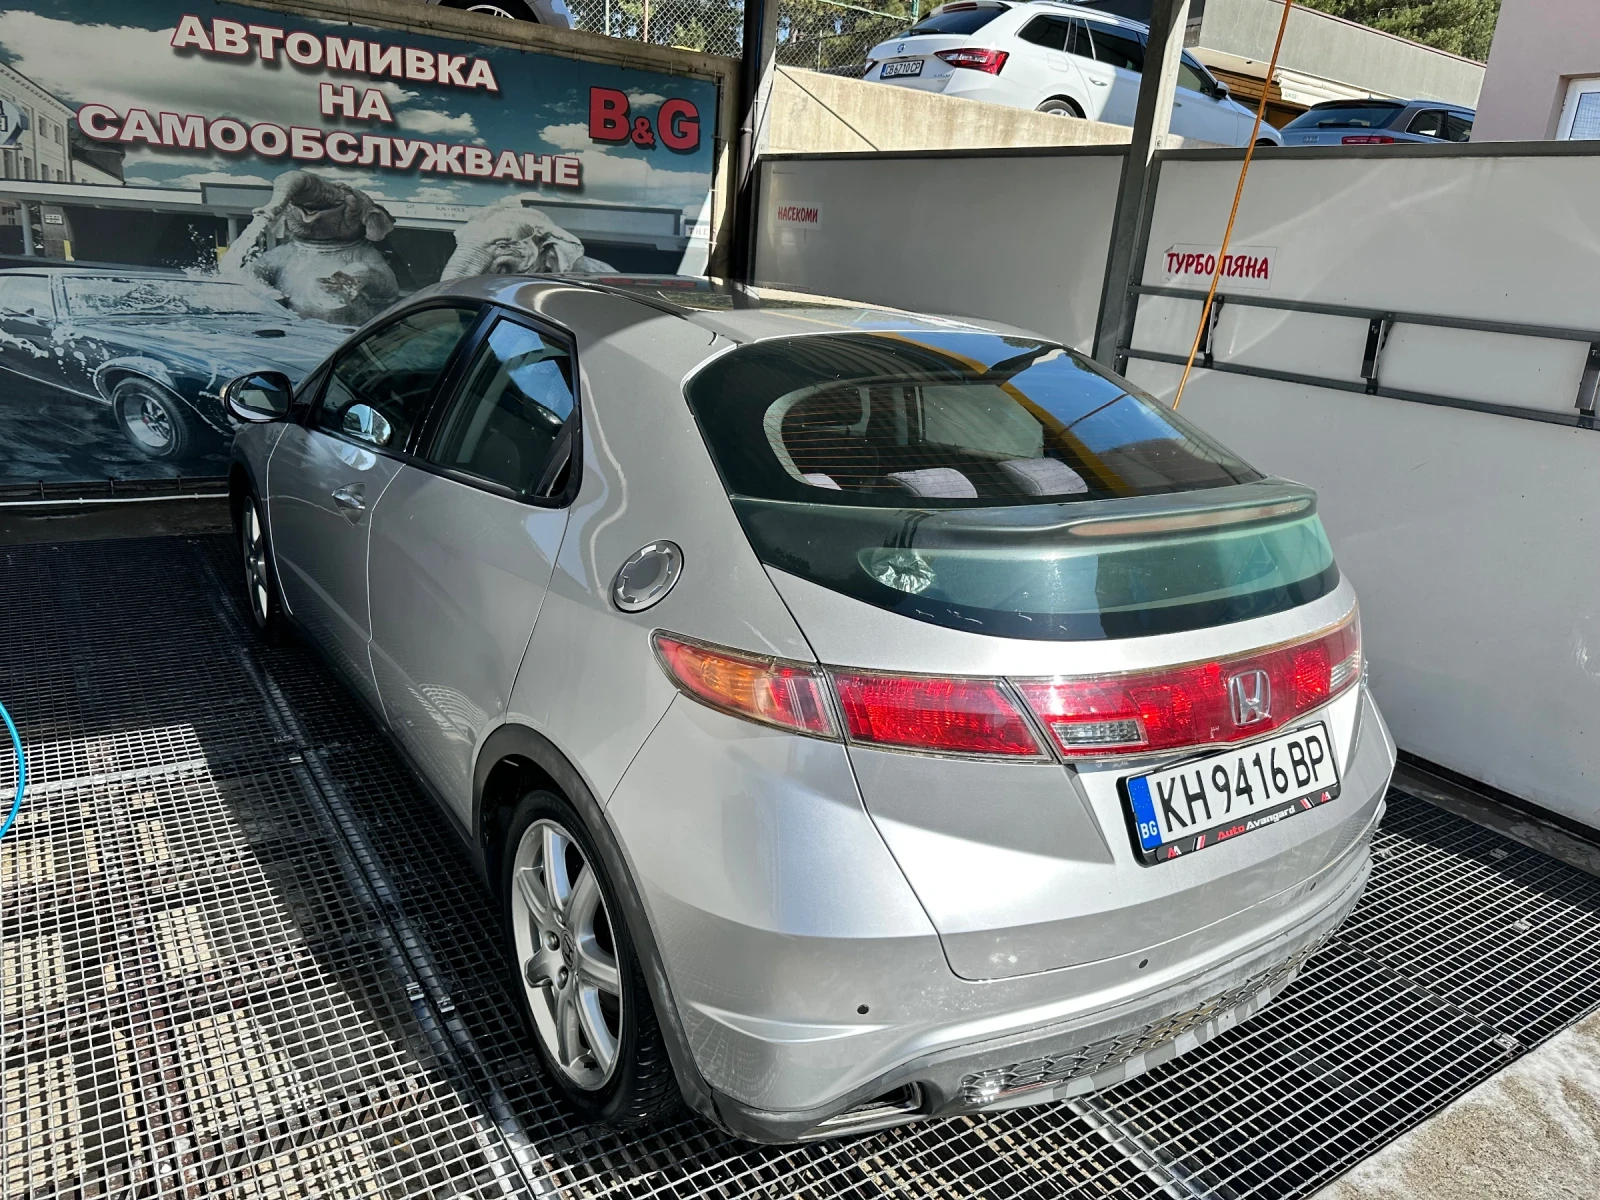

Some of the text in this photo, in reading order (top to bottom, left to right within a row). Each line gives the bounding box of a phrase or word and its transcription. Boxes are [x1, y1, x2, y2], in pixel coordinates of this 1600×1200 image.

[170, 14, 499, 91] АВТОМИВКА
[319, 82, 393, 122] НА
[589, 86, 700, 150] B&G
[77, 103, 580, 187] САМООБСЛУЖВАНЕ
[777, 205, 819, 224] НАСЕКОМИ
[1167, 252, 1269, 280] ТУРБО ПЯНА
[1140, 821, 1159, 840] BG
